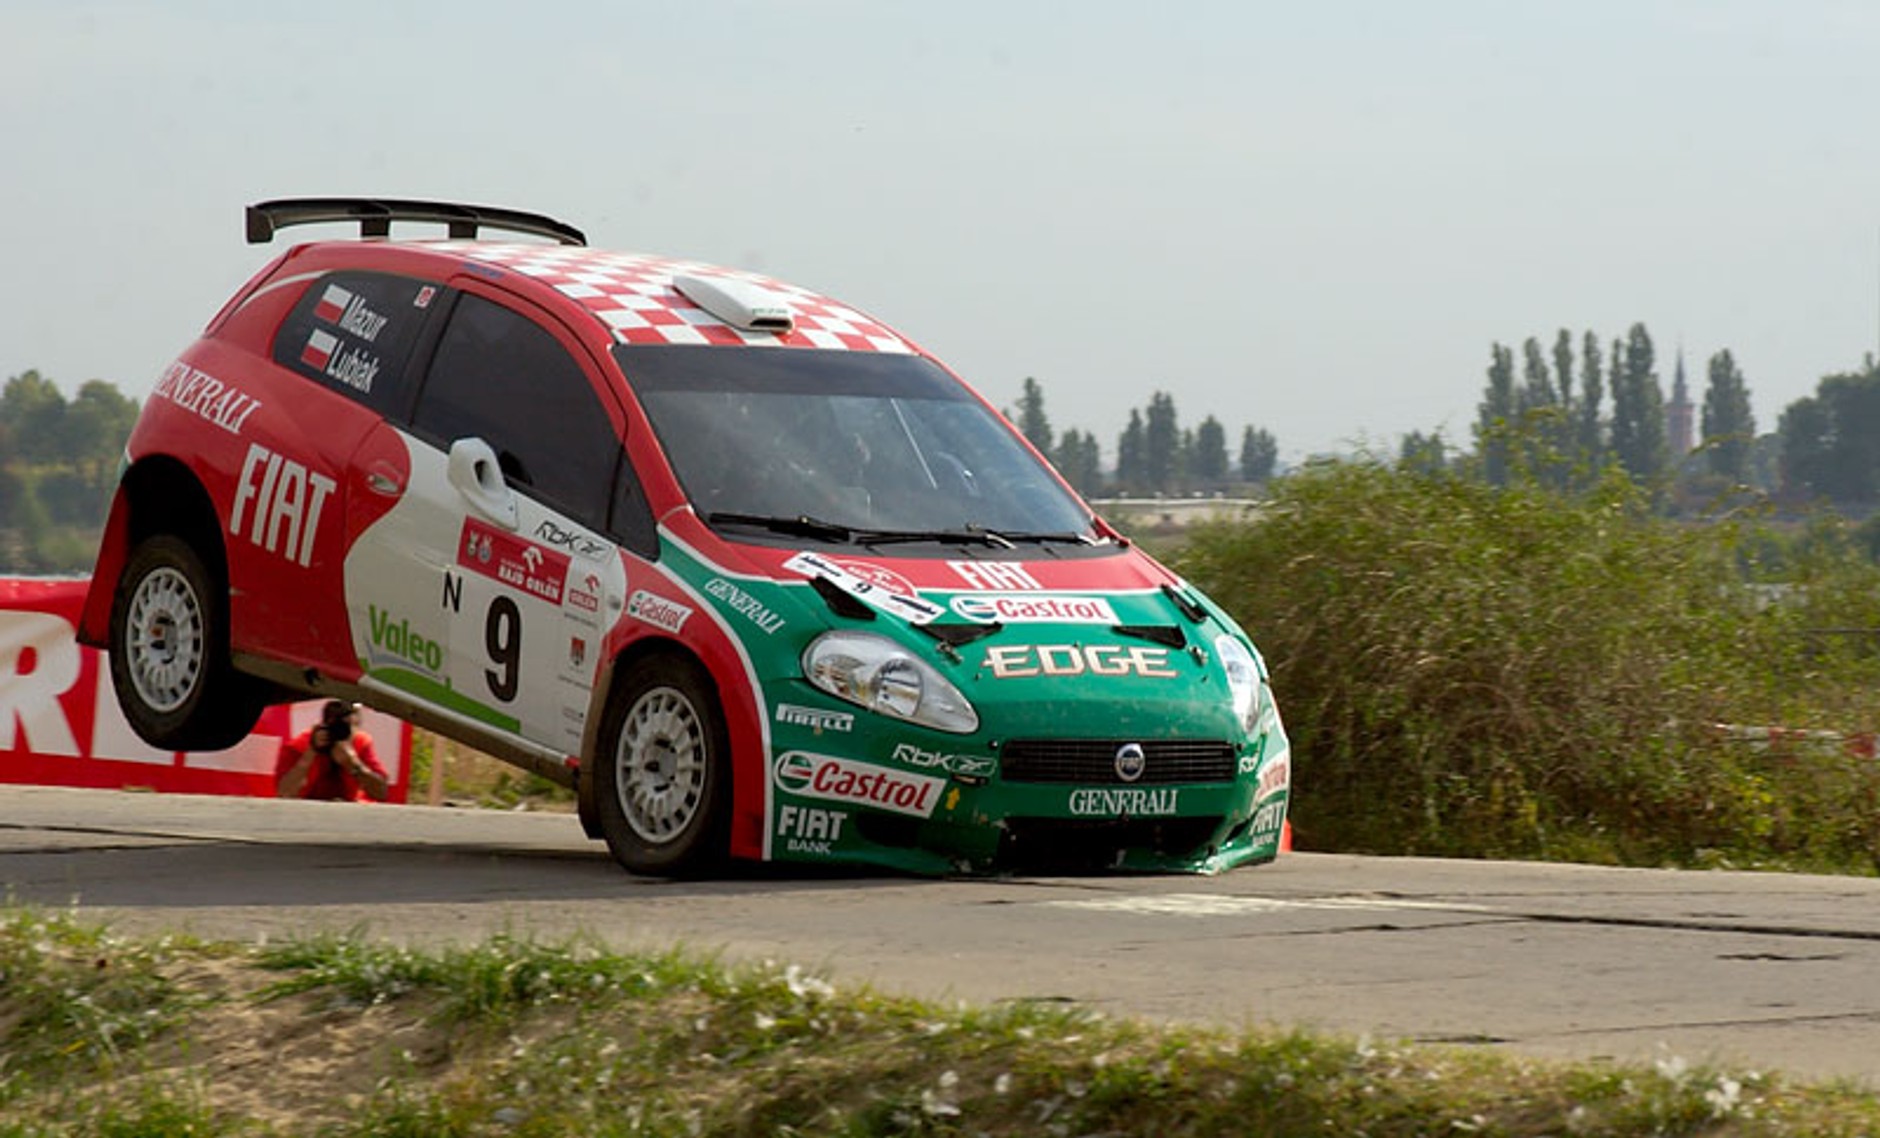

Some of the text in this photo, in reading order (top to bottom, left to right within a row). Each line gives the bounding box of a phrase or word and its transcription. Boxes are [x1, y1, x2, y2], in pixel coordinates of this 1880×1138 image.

[340, 294, 388, 342] Mazur
[327, 341, 380, 393] Lubiak
[153, 361, 262, 435] ENERALI
[230, 443, 337, 569] FIAT
[442, 571, 462, 613] N
[946, 561, 1043, 589] FIAT
[640, 598, 686, 629] Castrol
[705, 578, 786, 634] GENERALI
[996, 599, 1108, 619] Castrol
[368, 604, 443, 672] Valeo
[485, 595, 521, 703] 9
[978, 644, 1180, 678] EDGE
[775, 703, 855, 732] PIRELLI
[813, 761, 932, 811] Castrol
[1069, 789, 1178, 815] GENERALI
[778, 805, 848, 841] FIAT
[786, 838, 832, 855] BANK
